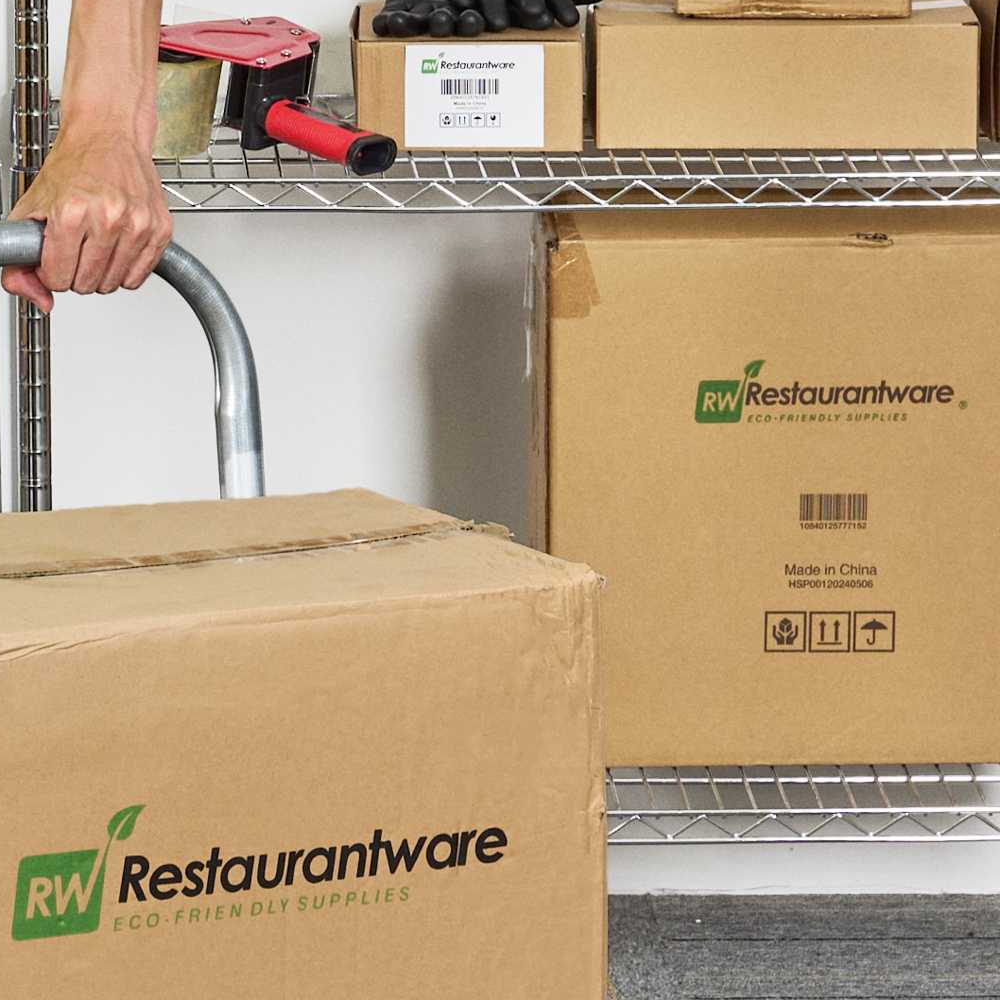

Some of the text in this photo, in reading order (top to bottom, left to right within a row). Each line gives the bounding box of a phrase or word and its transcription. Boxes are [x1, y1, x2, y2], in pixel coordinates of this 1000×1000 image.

[440, 60, 516, 70] Restaurantware
[703, 391, 738, 412] RW
[745, 380, 955, 406] Restaurantware
[747, 412, 909, 423] ECO-FRIENDLY SUPPLIES
[784, 563, 878, 576] Made in China
[117, 826, 508, 903] Restaurantware
[26, 876, 96, 920] RW
[113, 885, 411, 932] ECO-FRIENDLY SUPPLIES
